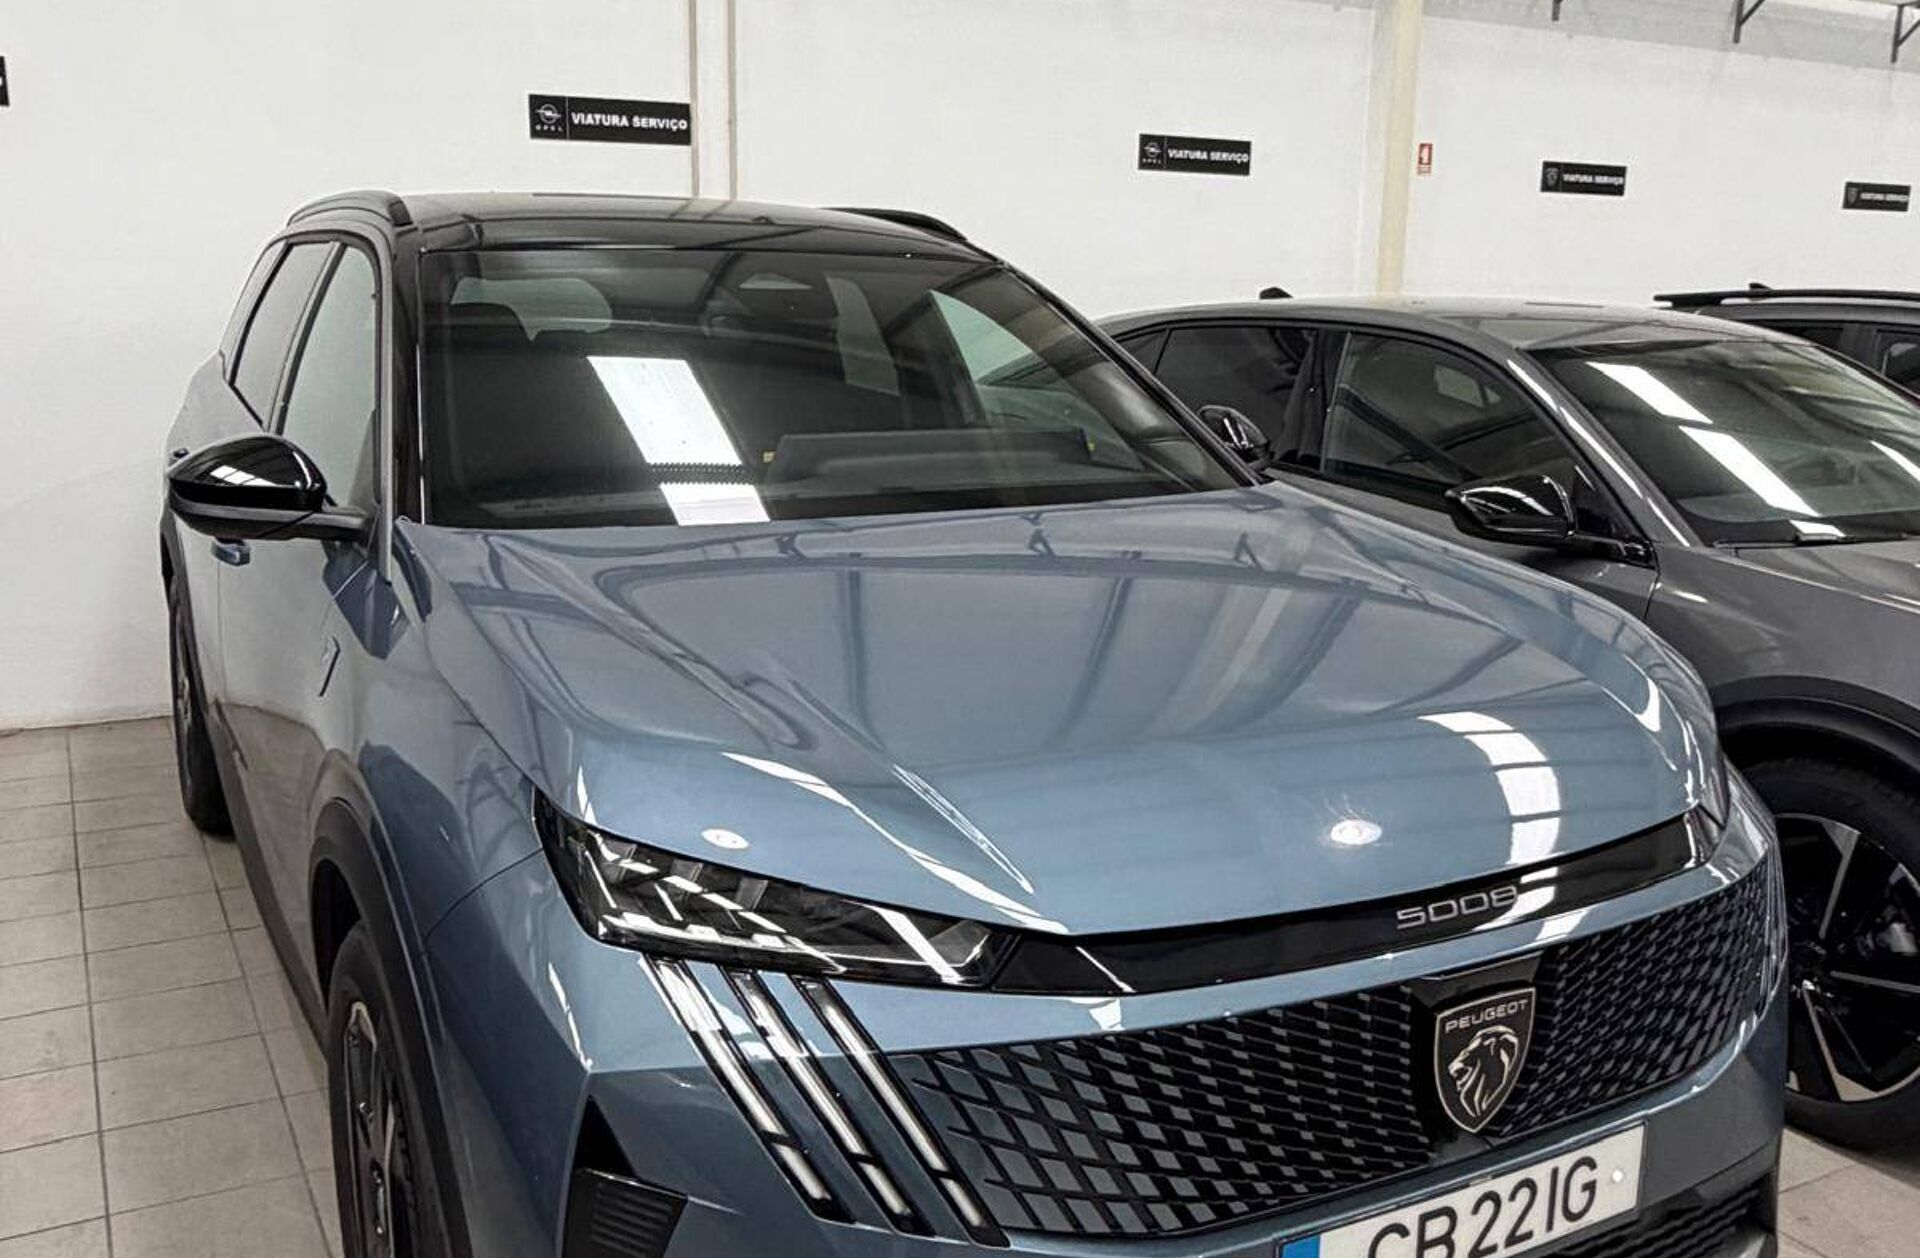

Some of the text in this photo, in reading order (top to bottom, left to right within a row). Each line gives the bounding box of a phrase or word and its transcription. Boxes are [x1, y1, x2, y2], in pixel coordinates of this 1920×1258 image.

[571, 112, 688, 132] VIATURA SERVIÇO
[1167, 148, 1249, 164] VIATURA SERVIÇO
[1396, 885, 1518, 930] 5008
[1445, 999, 1528, 1034] PEUGEOT
